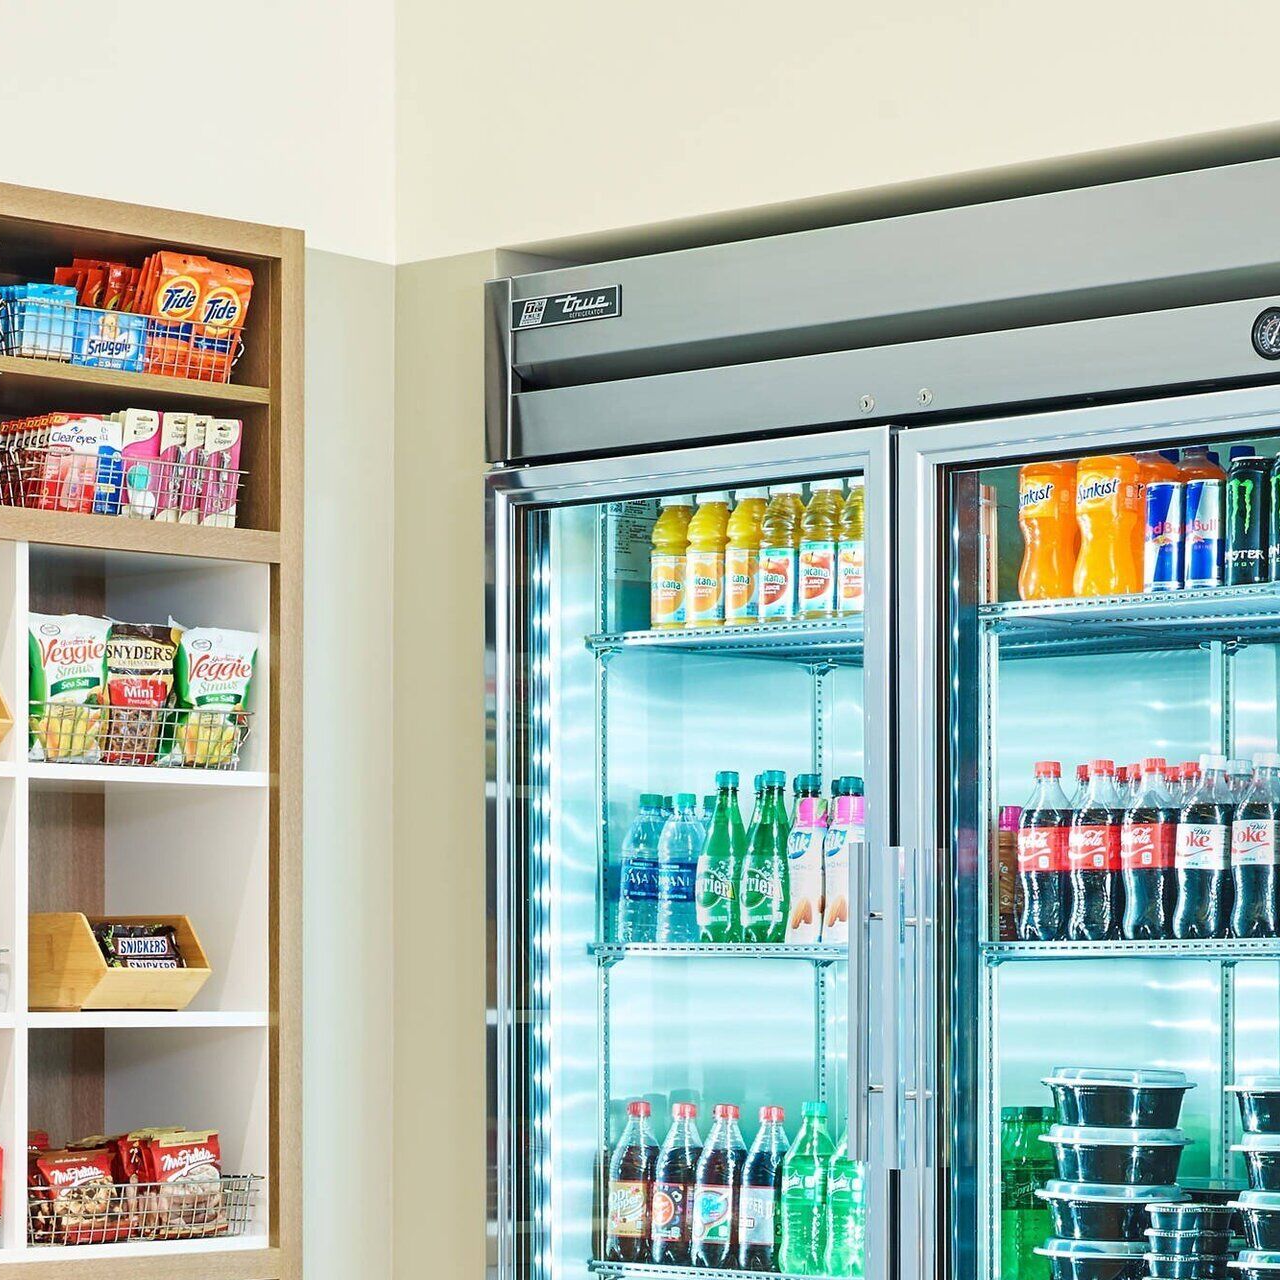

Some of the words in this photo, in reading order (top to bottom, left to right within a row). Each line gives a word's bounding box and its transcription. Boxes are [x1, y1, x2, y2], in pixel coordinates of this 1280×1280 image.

[165, 287, 196, 312] Tide
[203, 298, 237, 323] Tide
[569, 309, 604, 318] REFRIGERATOR
[87, 338, 132, 359] Snuggle
[51, 432, 76, 443] Clear
[76, 434, 96, 446] eyes
[39, 638, 104, 666] Veggie
[106, 644, 172, 661] SNYDER'S
[188, 653, 252, 682] Veggie
[123, 686, 154, 699] Mini
[120, 939, 166, 954] SNICKERS
